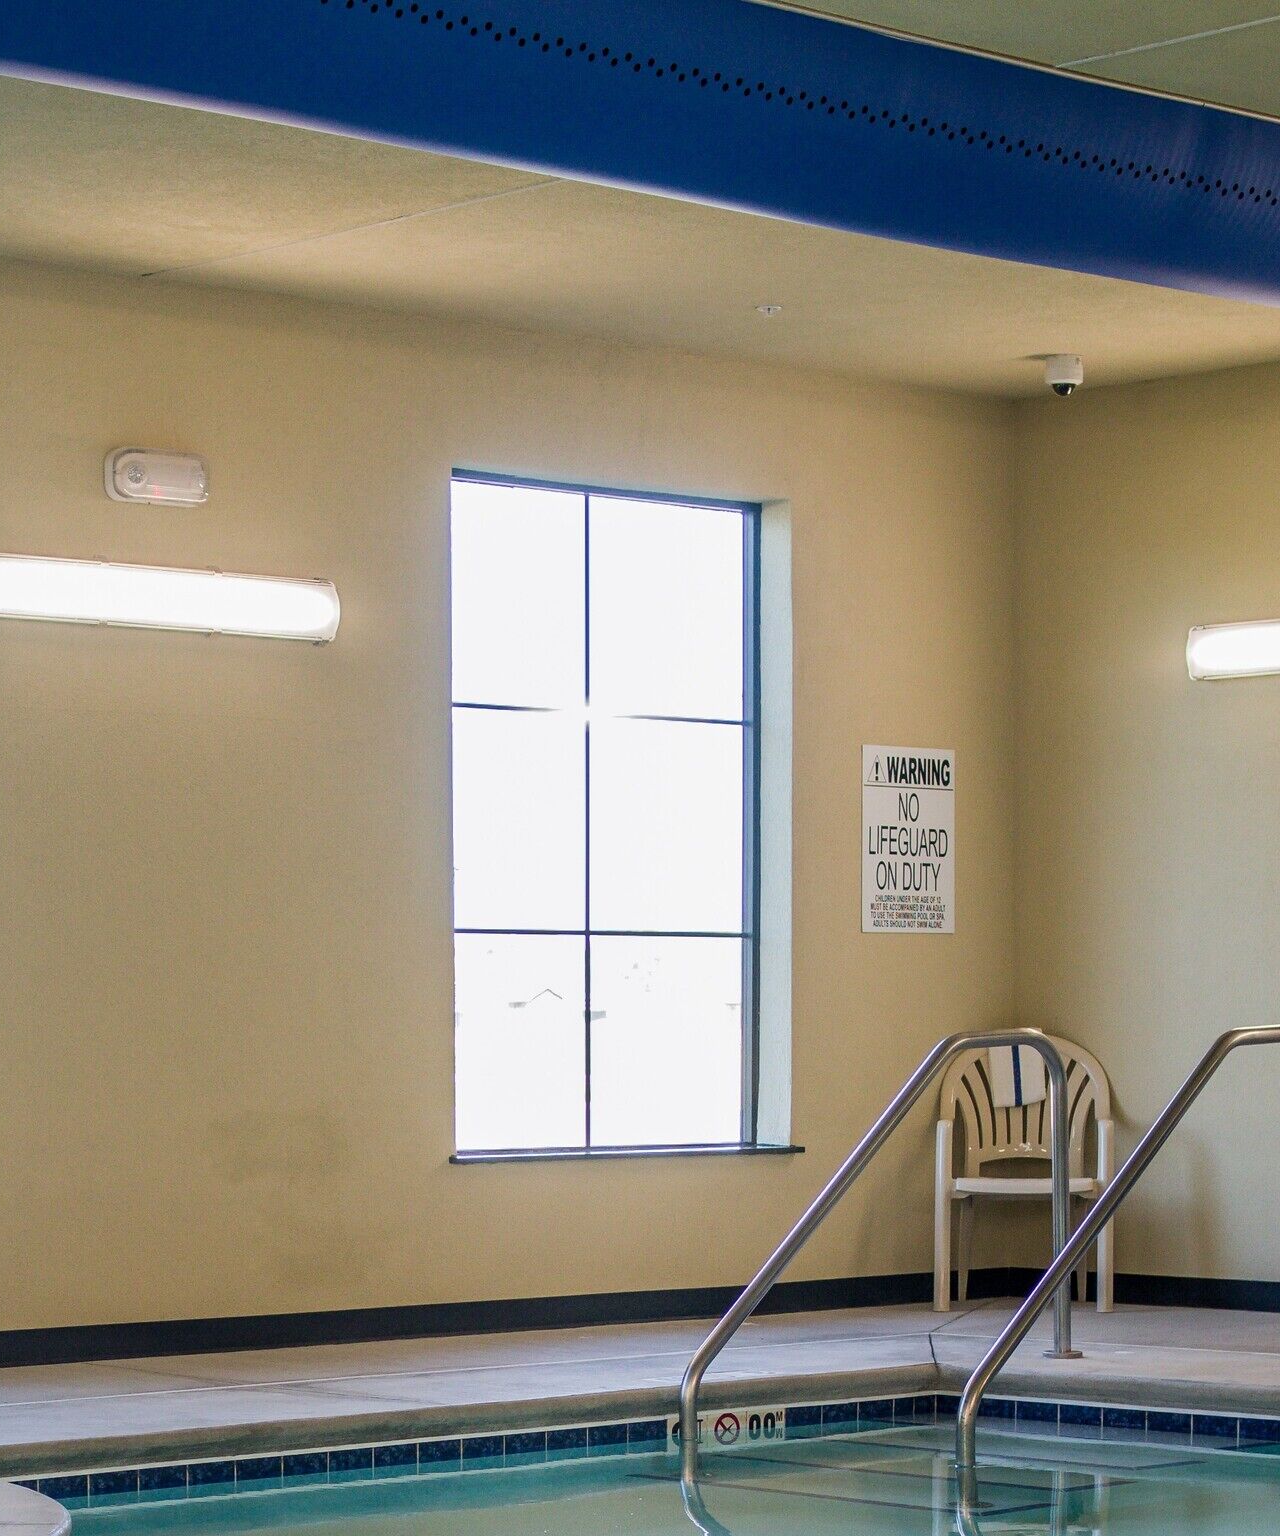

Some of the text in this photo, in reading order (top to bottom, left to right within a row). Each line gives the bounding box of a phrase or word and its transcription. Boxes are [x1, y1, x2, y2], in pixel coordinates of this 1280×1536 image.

[887, 756, 951, 787] WARNING
[898, 792, 920, 823] NO
[868, 825, 948, 858] LIFEGUARD
[876, 861, 941, 892] ON DUTY
